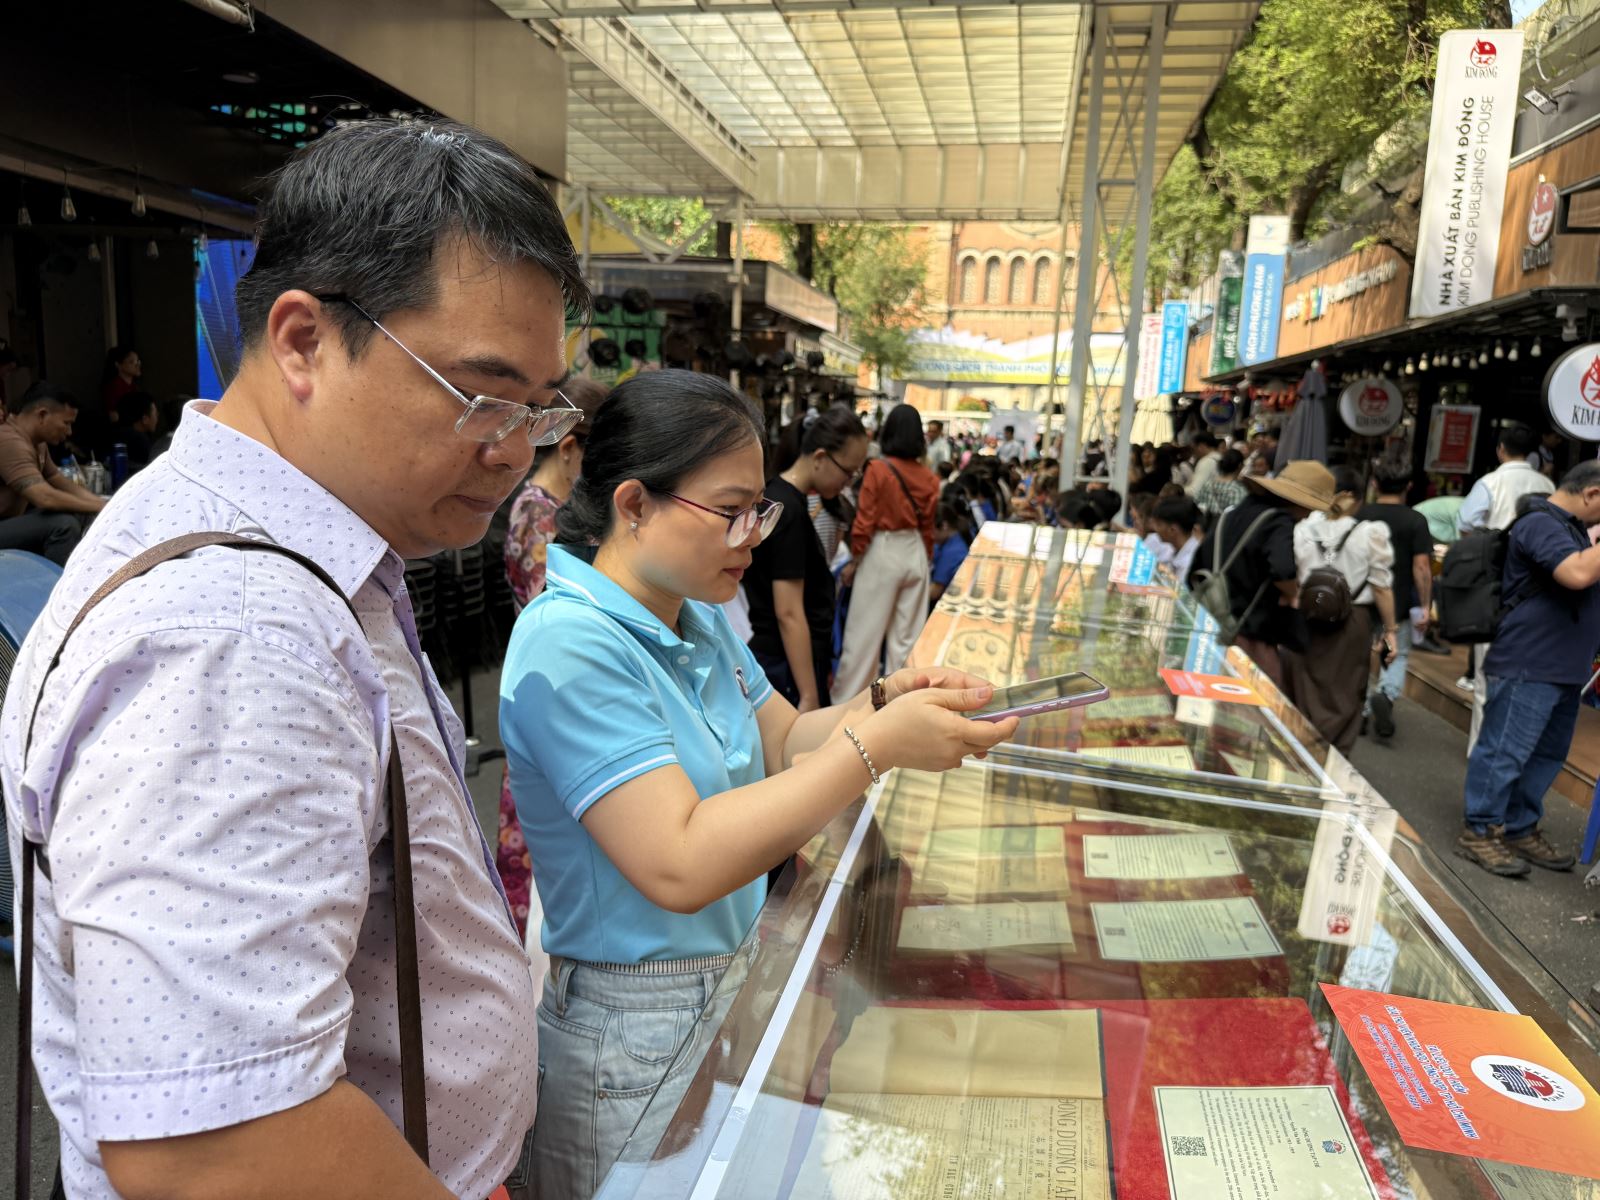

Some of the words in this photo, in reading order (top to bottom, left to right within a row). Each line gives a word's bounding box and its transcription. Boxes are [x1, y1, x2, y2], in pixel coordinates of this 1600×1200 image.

[1456, 97, 1475, 148] ĐỒNG
[1476, 95, 1495, 144] HOUSE
[1453, 153, 1467, 182] KIM
[1466, 147, 1487, 228] PUBLISHING
[1445, 188, 1463, 221] BẢN
[1442, 227, 1459, 267] XUẤT
[1460, 231, 1477, 279] DONG
[1438, 270, 1454, 306] NHÀ
[1456, 282, 1471, 307] KIM
[1571, 404, 1595, 425] KIM
[1055, 1129, 1077, 1174] DƯƠNG
